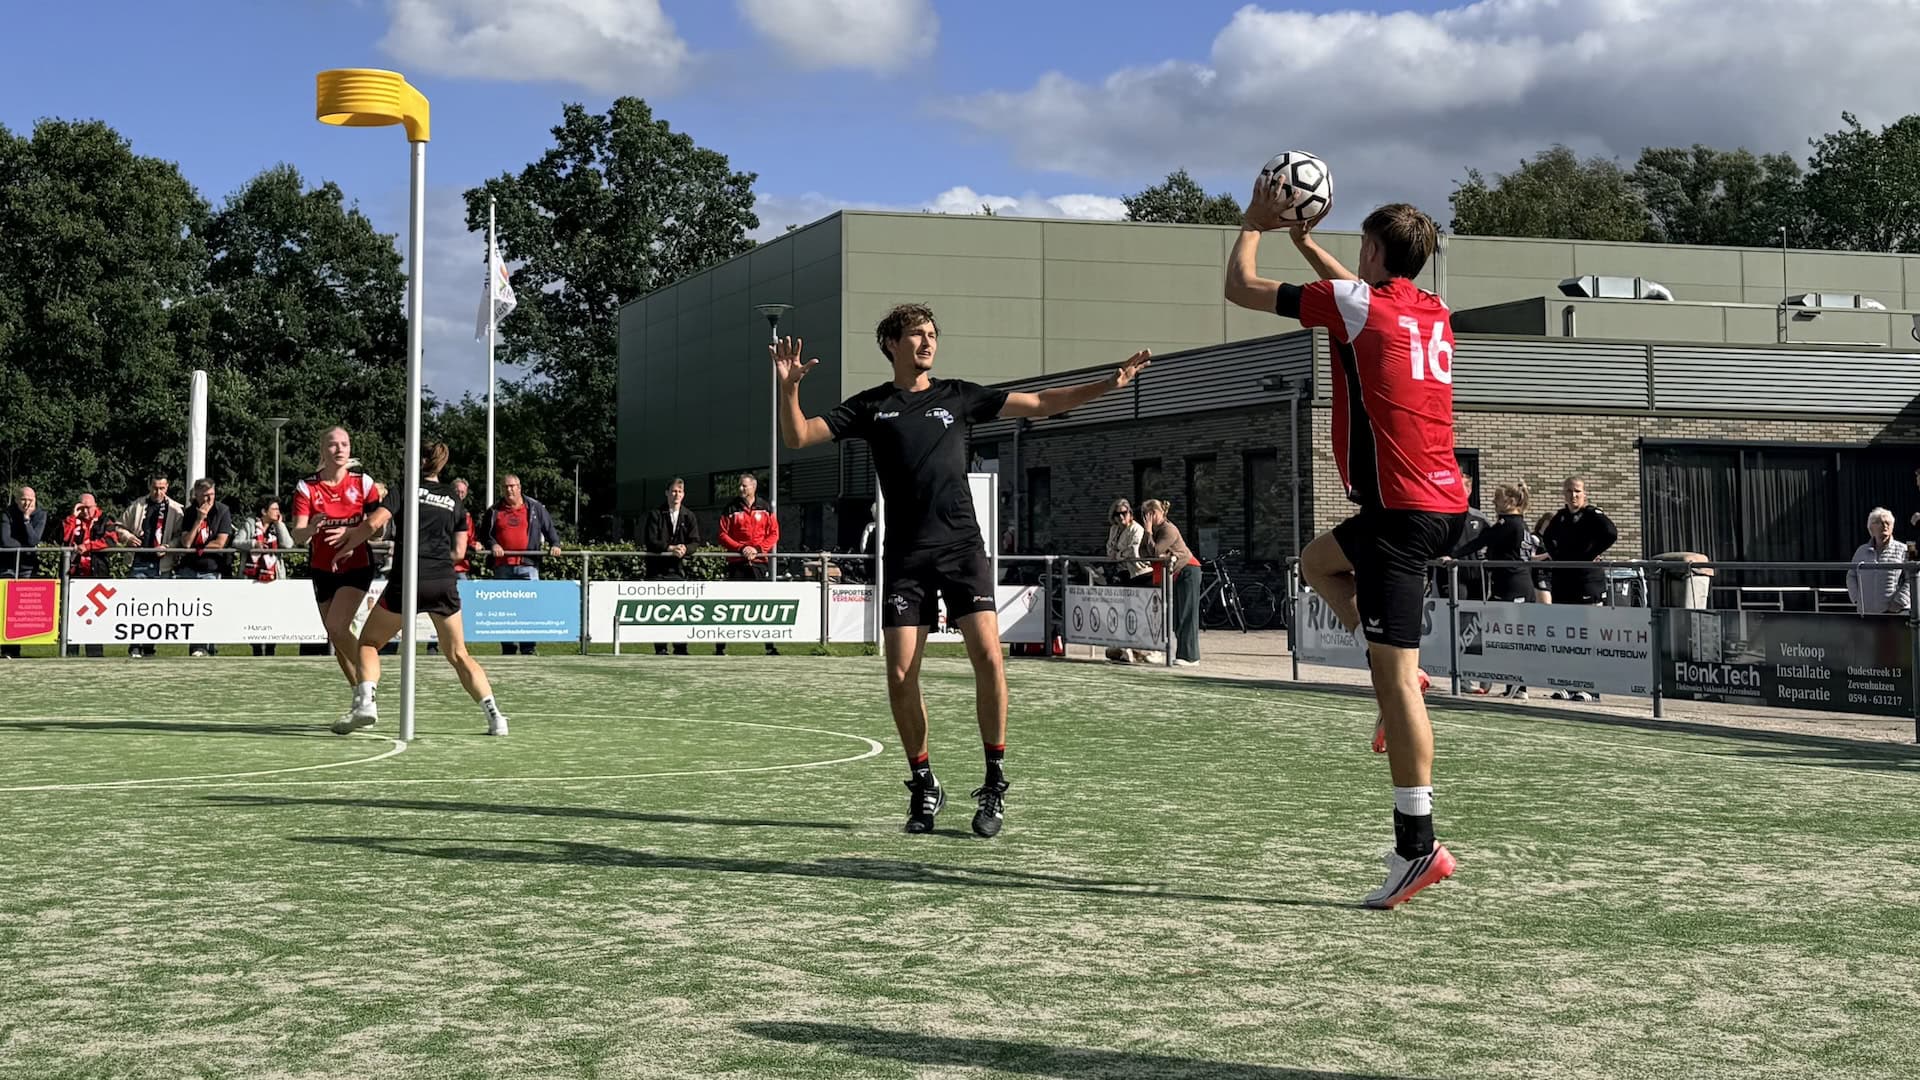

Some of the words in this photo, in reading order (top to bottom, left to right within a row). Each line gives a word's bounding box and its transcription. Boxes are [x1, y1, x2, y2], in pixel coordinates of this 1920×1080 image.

[1398, 314, 1452, 385] 16
[475, 589, 538, 601] Hypotheken
[617, 583, 707, 598] Loonbedrijf
[116, 597, 213, 617] nienhuis
[619, 603, 705, 622] LUCAS
[711, 603, 795, 622] STUUT
[114, 623, 195, 640] SPORT
[686, 626, 793, 639] Jonkersvaart
[1485, 621, 1536, 637] JAGER
[1546, 625, 1556, 638] &
[1566, 627, 1589, 640] DE
[1599, 628, 1648, 644] WITH
[1551, 645, 1592, 656] TUINHOUT
[1596, 649, 1648, 660] HOUTBOUW
[1780, 642, 1825, 661] Verkoop
[1675, 661, 1719, 684] Flonk
[1720, 664, 1761, 687] Tech
[1776, 663, 1831, 680] Installatie
[1847, 665, 1890, 678] Oudestreek
[1892, 667, 1902, 678] 13
[1778, 684, 1831, 702] Reparatie
[1847, 679, 1895, 692] Zevenhuizen
[1848, 693, 1867, 704] 0594
[1873, 694, 1903, 705] 631217
